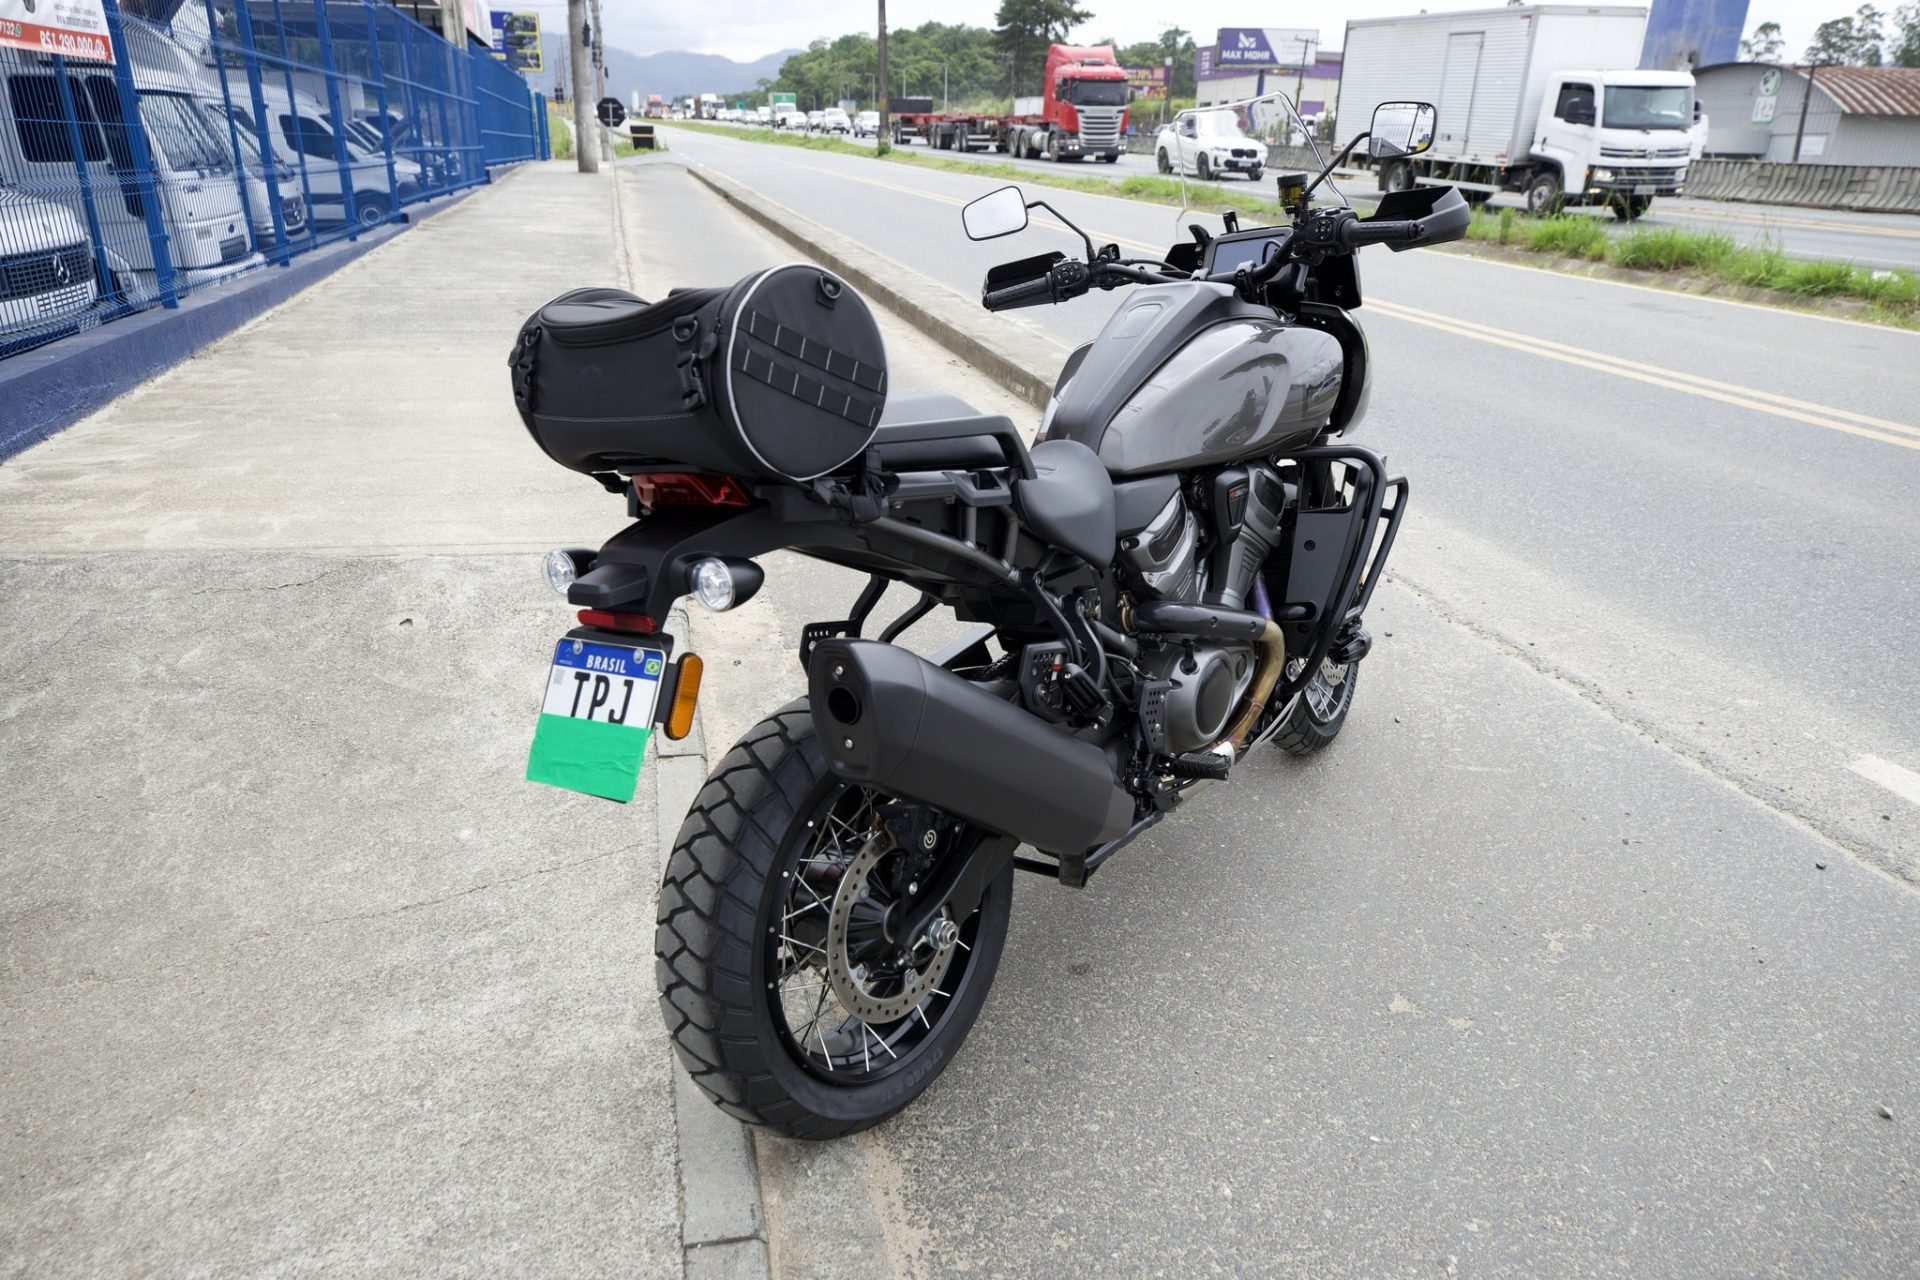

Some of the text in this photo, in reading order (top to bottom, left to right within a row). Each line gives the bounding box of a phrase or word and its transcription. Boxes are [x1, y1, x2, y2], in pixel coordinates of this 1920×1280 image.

[1222, 50, 1271, 60] MAX MOHR
[586, 654, 626, 674] BRASIL
[570, 671, 634, 725] TPJ
